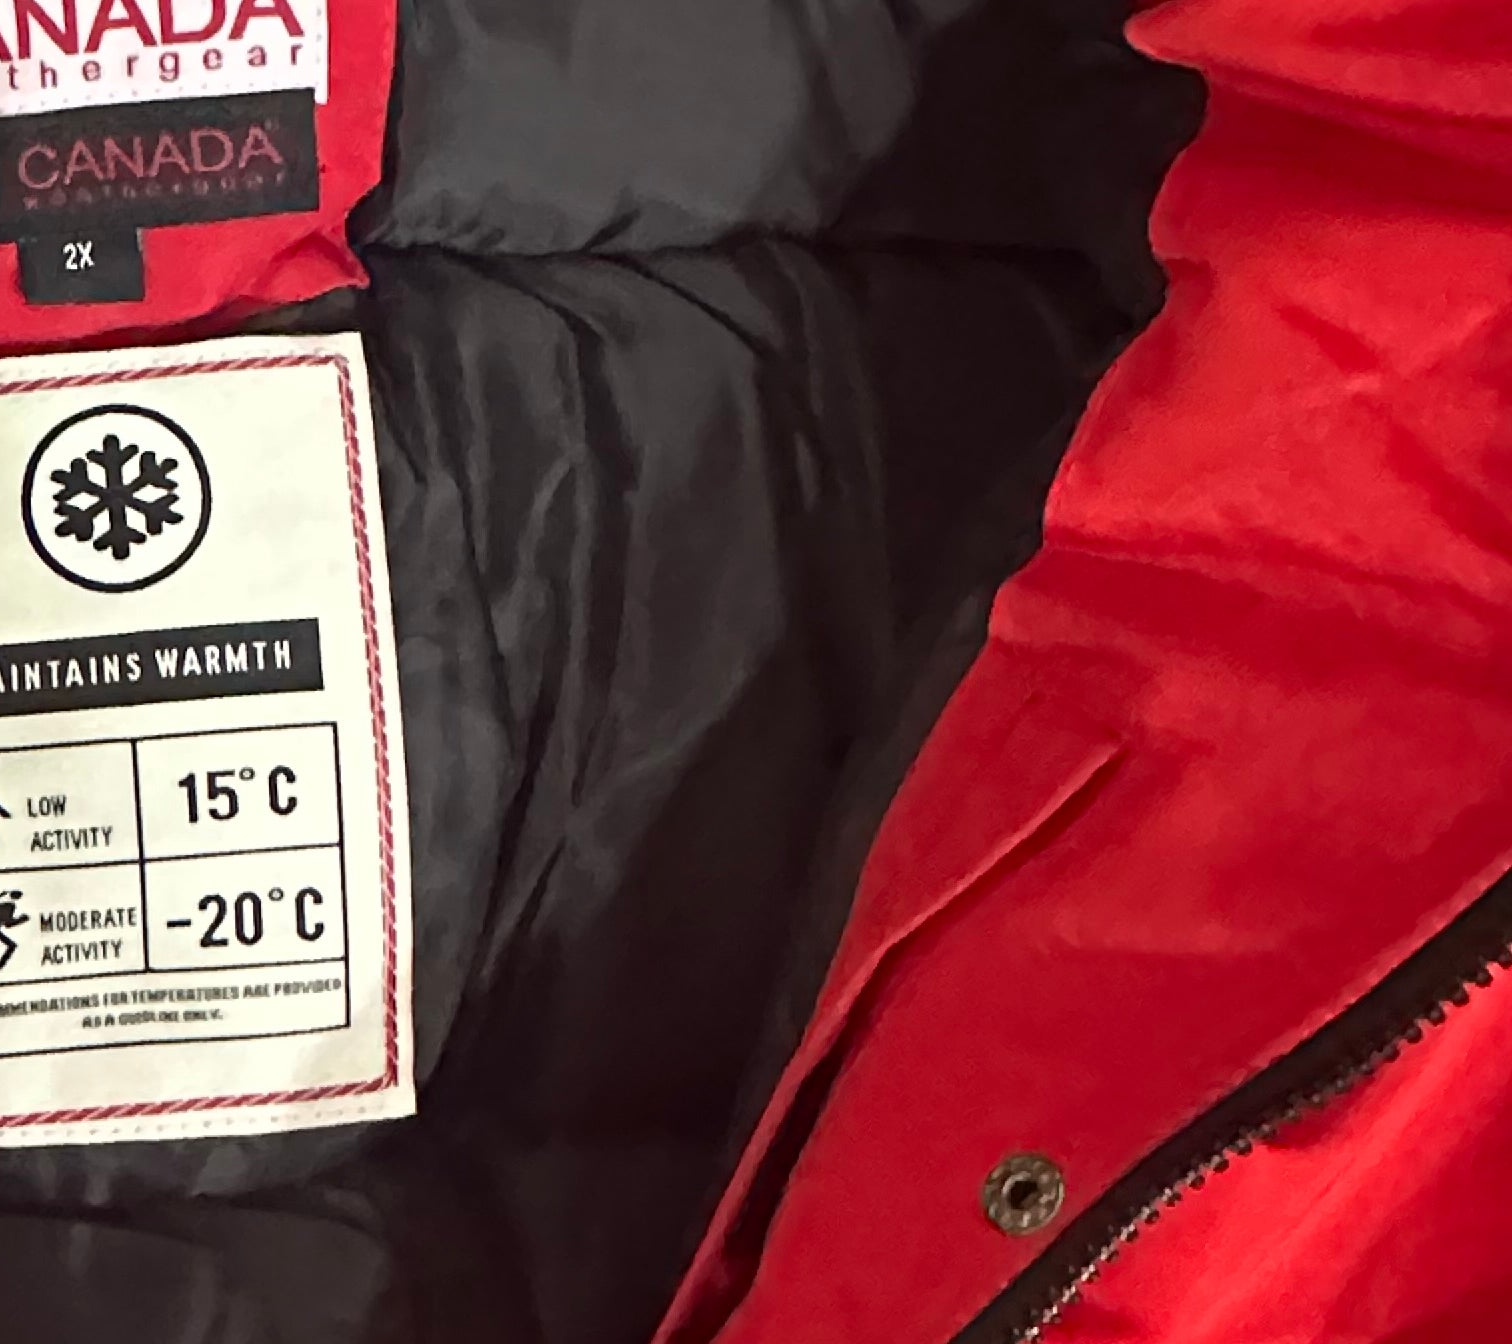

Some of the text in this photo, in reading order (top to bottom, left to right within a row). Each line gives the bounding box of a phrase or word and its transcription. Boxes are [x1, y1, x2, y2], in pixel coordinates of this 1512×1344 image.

[63, 242, 95, 270] 2X
[154, 639, 292, 679] WARMTH
[26, 794, 67, 819] LOW
[30, 825, 113, 854] ACTIVITY
[39, 906, 137, 933] MODERATE
[41, 939, 123, 967] ACTIVITY
